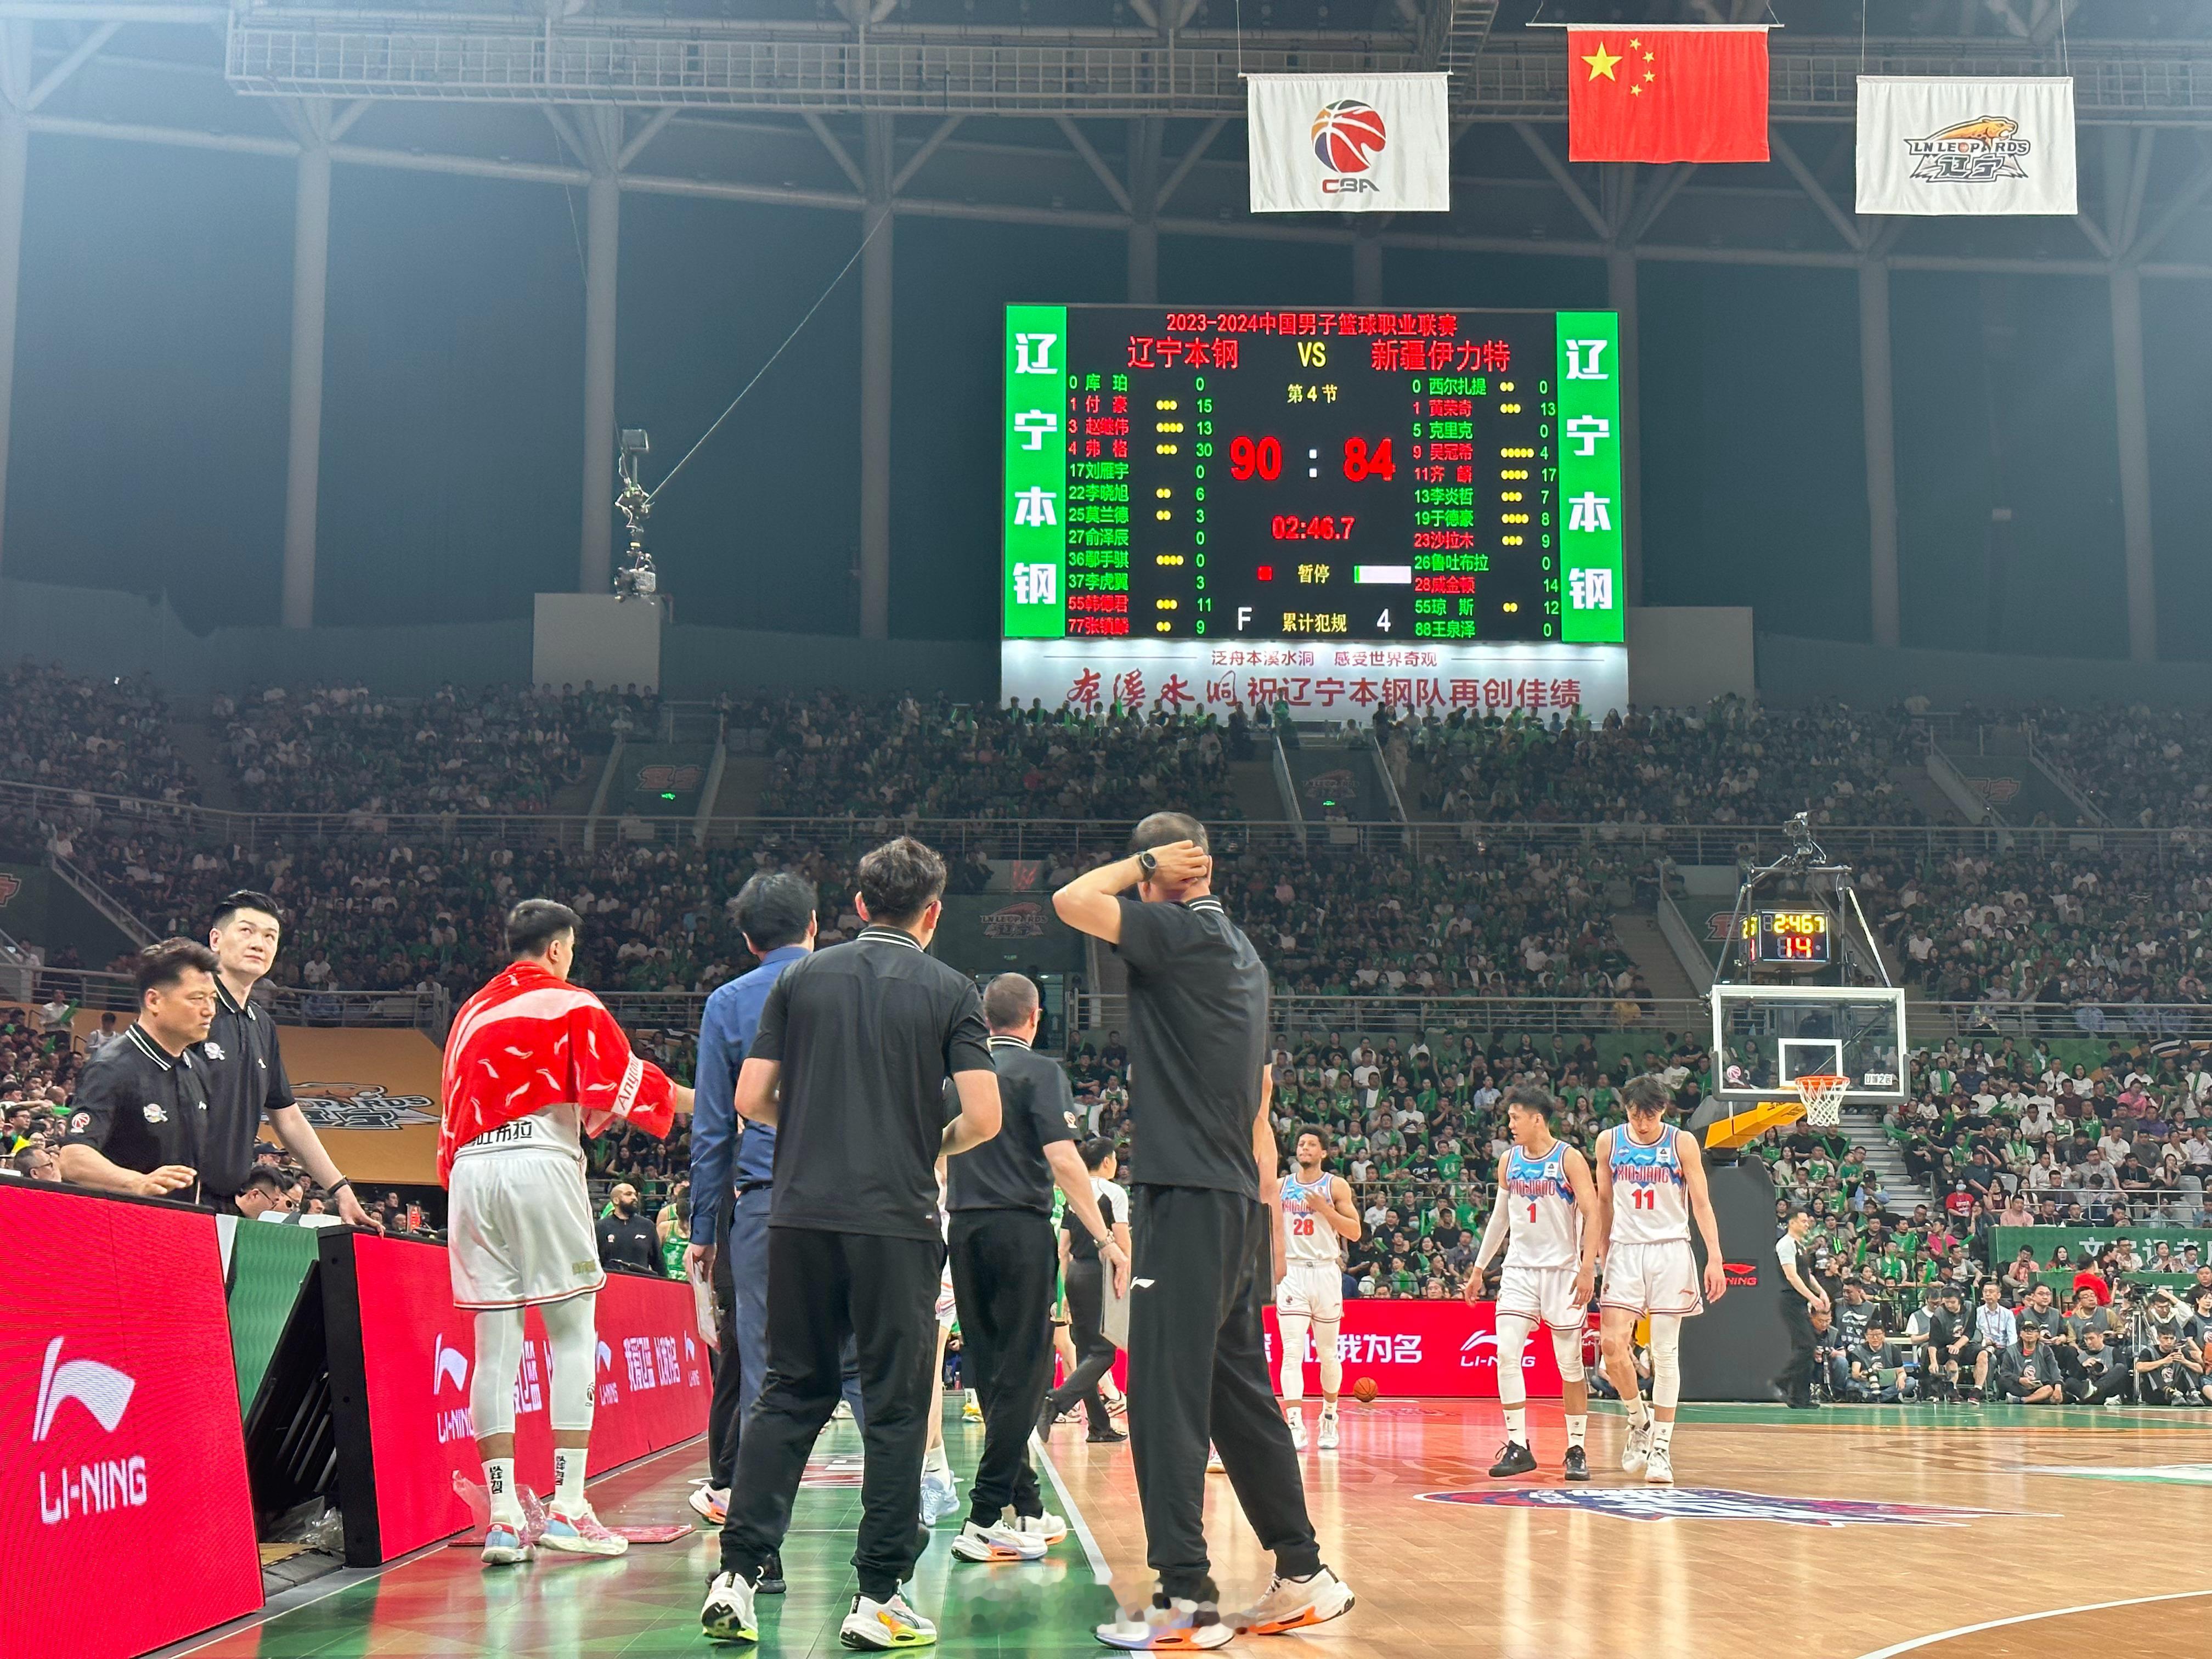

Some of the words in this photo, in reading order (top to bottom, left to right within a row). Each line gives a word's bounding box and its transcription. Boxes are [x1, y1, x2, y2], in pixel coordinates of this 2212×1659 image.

[1914, 143, 1933, 153] LN
[1938, 141, 2027, 153] LEOPARDS
[1322, 177, 1380, 194] CBA
[1166, 312, 1458, 336] 2023-2024中国男子篮球职业联赛
[1127, 336, 1238, 369] 辽宁本钢
[1297, 341, 1326, 368] VS
[1371, 338, 1511, 372] 新疆伊力特
[1195, 377, 1205, 391] 0
[1539, 380, 1548, 394] 0
[1197, 398, 1212, 413] 15
[1541, 402, 1556, 416] 13
[1197, 421, 1212, 435] 13
[1413, 423, 1421, 437] 5
[1429, 421, 1473, 439] 克里克
[1540, 424, 1548, 438] 0
[1196, 442, 1212, 457] 30
[1413, 445, 1422, 460] 9
[1540, 446, 1549, 460] 4
[1229, 436, 1282, 481] 90
[1342, 437, 1396, 482] 84
[1195, 465, 1205, 479] 0
[1542, 468, 1556, 482] 17
[1195, 487, 1205, 501] 6
[1541, 490, 1549, 504] 7
[1196, 509, 1205, 523] 3
[1542, 512, 1550, 526] 8
[1272, 515, 1355, 541] 02:46.7
[1196, 531, 1205, 545] 0
[1542, 534, 1550, 548] 9
[1195, 553, 1205, 567] 0
[1542, 556, 1551, 571] 0
[1297, 564, 1330, 584] 暂停
[1196, 575, 1205, 590] 3
[1543, 578, 1559, 592] 14
[1197, 597, 1211, 612] 11
[1544, 601, 1559, 614] 12
[1196, 620, 1205, 634] 9
[1237, 606, 1253, 631] F
[1282, 612, 1347, 633] 累计犯规
[1376, 608, 1392, 633] 4
[1543, 623, 1551, 637] 0
[1211, 650, 1314, 667] 泛舟本溪水洞
[1334, 651, 1438, 667] 感受世界奇观
[1247, 676, 1582, 709] 祝辽宁本钢队再创佳绩
[1786, 936, 1813, 958] 14
[1617, 1165, 1669, 1183] XINJIANG
[1509, 1179, 1556, 1197] XINJIANG
[1631, 1188, 1655, 1210] 11
[1527, 1203, 1537, 1223] 1
[1293, 1218, 1314, 1235] 28
[1725, 1277, 1757, 1286] NING
[1460, 1355, 1536, 1368] LI-NG
[40, 1455, 148, 1525] LI-NING
